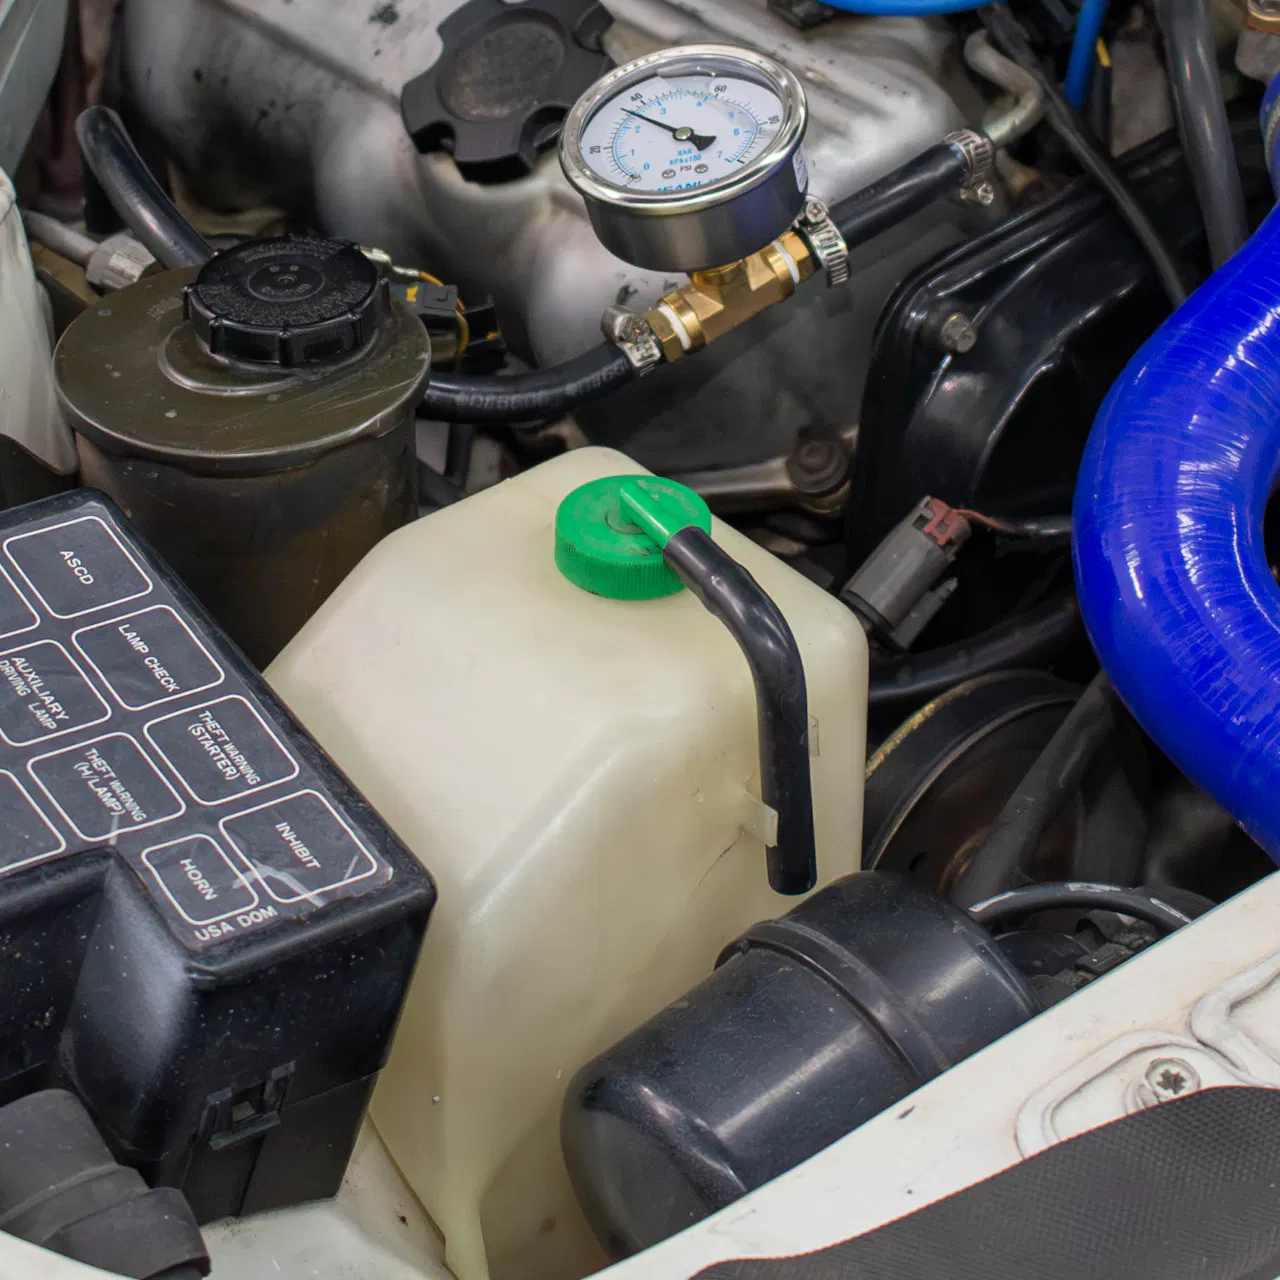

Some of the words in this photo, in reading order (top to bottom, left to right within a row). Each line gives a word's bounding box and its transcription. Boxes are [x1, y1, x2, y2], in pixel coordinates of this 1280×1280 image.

[629, 93, 643, 103] 40
[714, 84, 727, 93] 60
[659, 106, 667, 116] 3
[589, 145, 602, 155] 20
[643, 162, 650, 171] 0
[677, 147, 693, 157] BAR
[716, 150, 723, 159] 7
[680, 164, 693, 173] PSI
[60, 550, 94, 585] ASCD
[118, 623, 149, 654] LAMP
[144, 656, 181, 693] CHECK
[11, 656, 70, 721] AUXILIARY
[27, 703, 58, 731] LAMP
[187, 722, 240, 780] (STARTER)
[197, 710, 229, 743] THEFT
[222, 740, 261, 785] WARNING
[73, 761, 126, 816] (H/LAMP)
[83, 747, 113, 779] THEFT
[109, 777, 148, 823] WARNING
[275, 821, 321, 870] INHIBIT
[179, 858, 218, 901] HORN
[194, 921, 235, 943] USA
[237, 905, 279, 928] DOM
